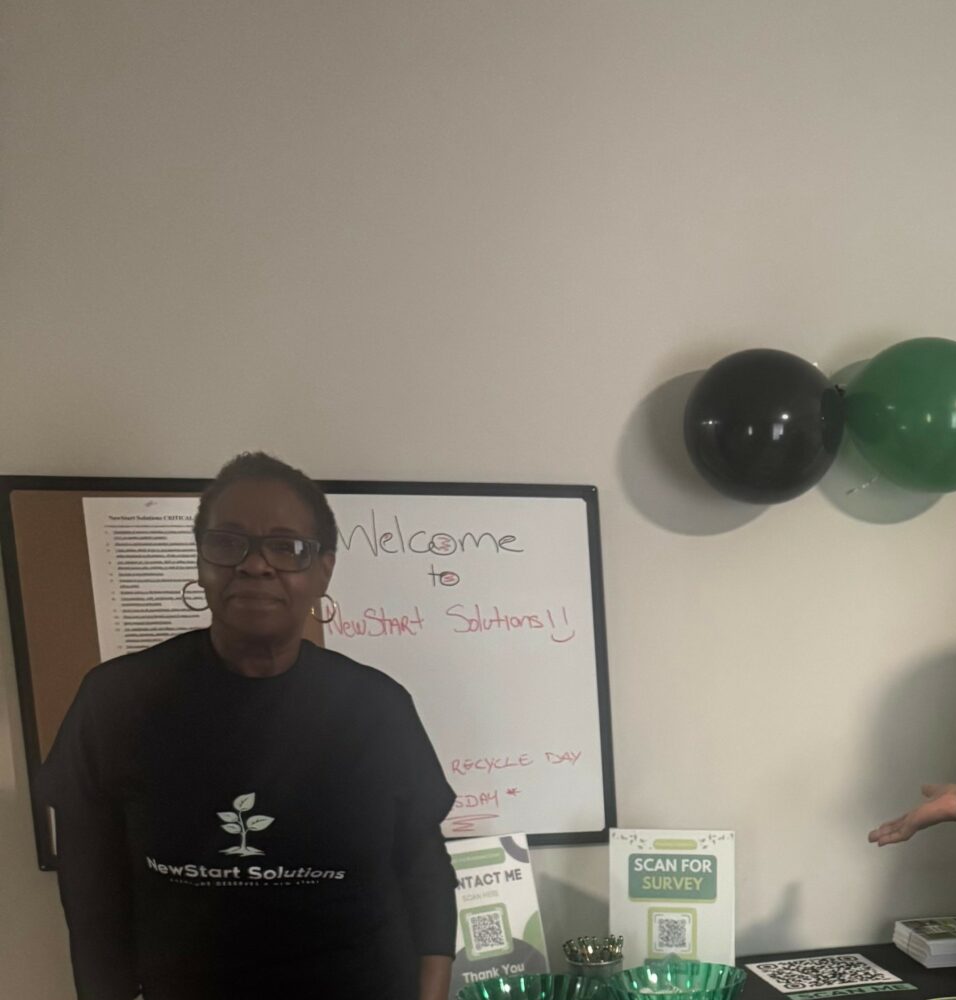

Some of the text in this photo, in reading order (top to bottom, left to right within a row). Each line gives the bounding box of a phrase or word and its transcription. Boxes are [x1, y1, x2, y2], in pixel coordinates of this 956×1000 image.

[337, 509, 524, 556] Welcome
[428, 564, 460, 586] to
[452, 752, 582, 776] RECYCLE DAY
[146, 856, 346, 880] NewStart Solutions
[504, 868, 523, 882] ME
[634, 858, 713, 874] SCAN FOR
[642, 876, 704, 892] SURVEY
[462, 963, 526, 984] Thank You
[799, 984, 910, 999] SCAN ME
